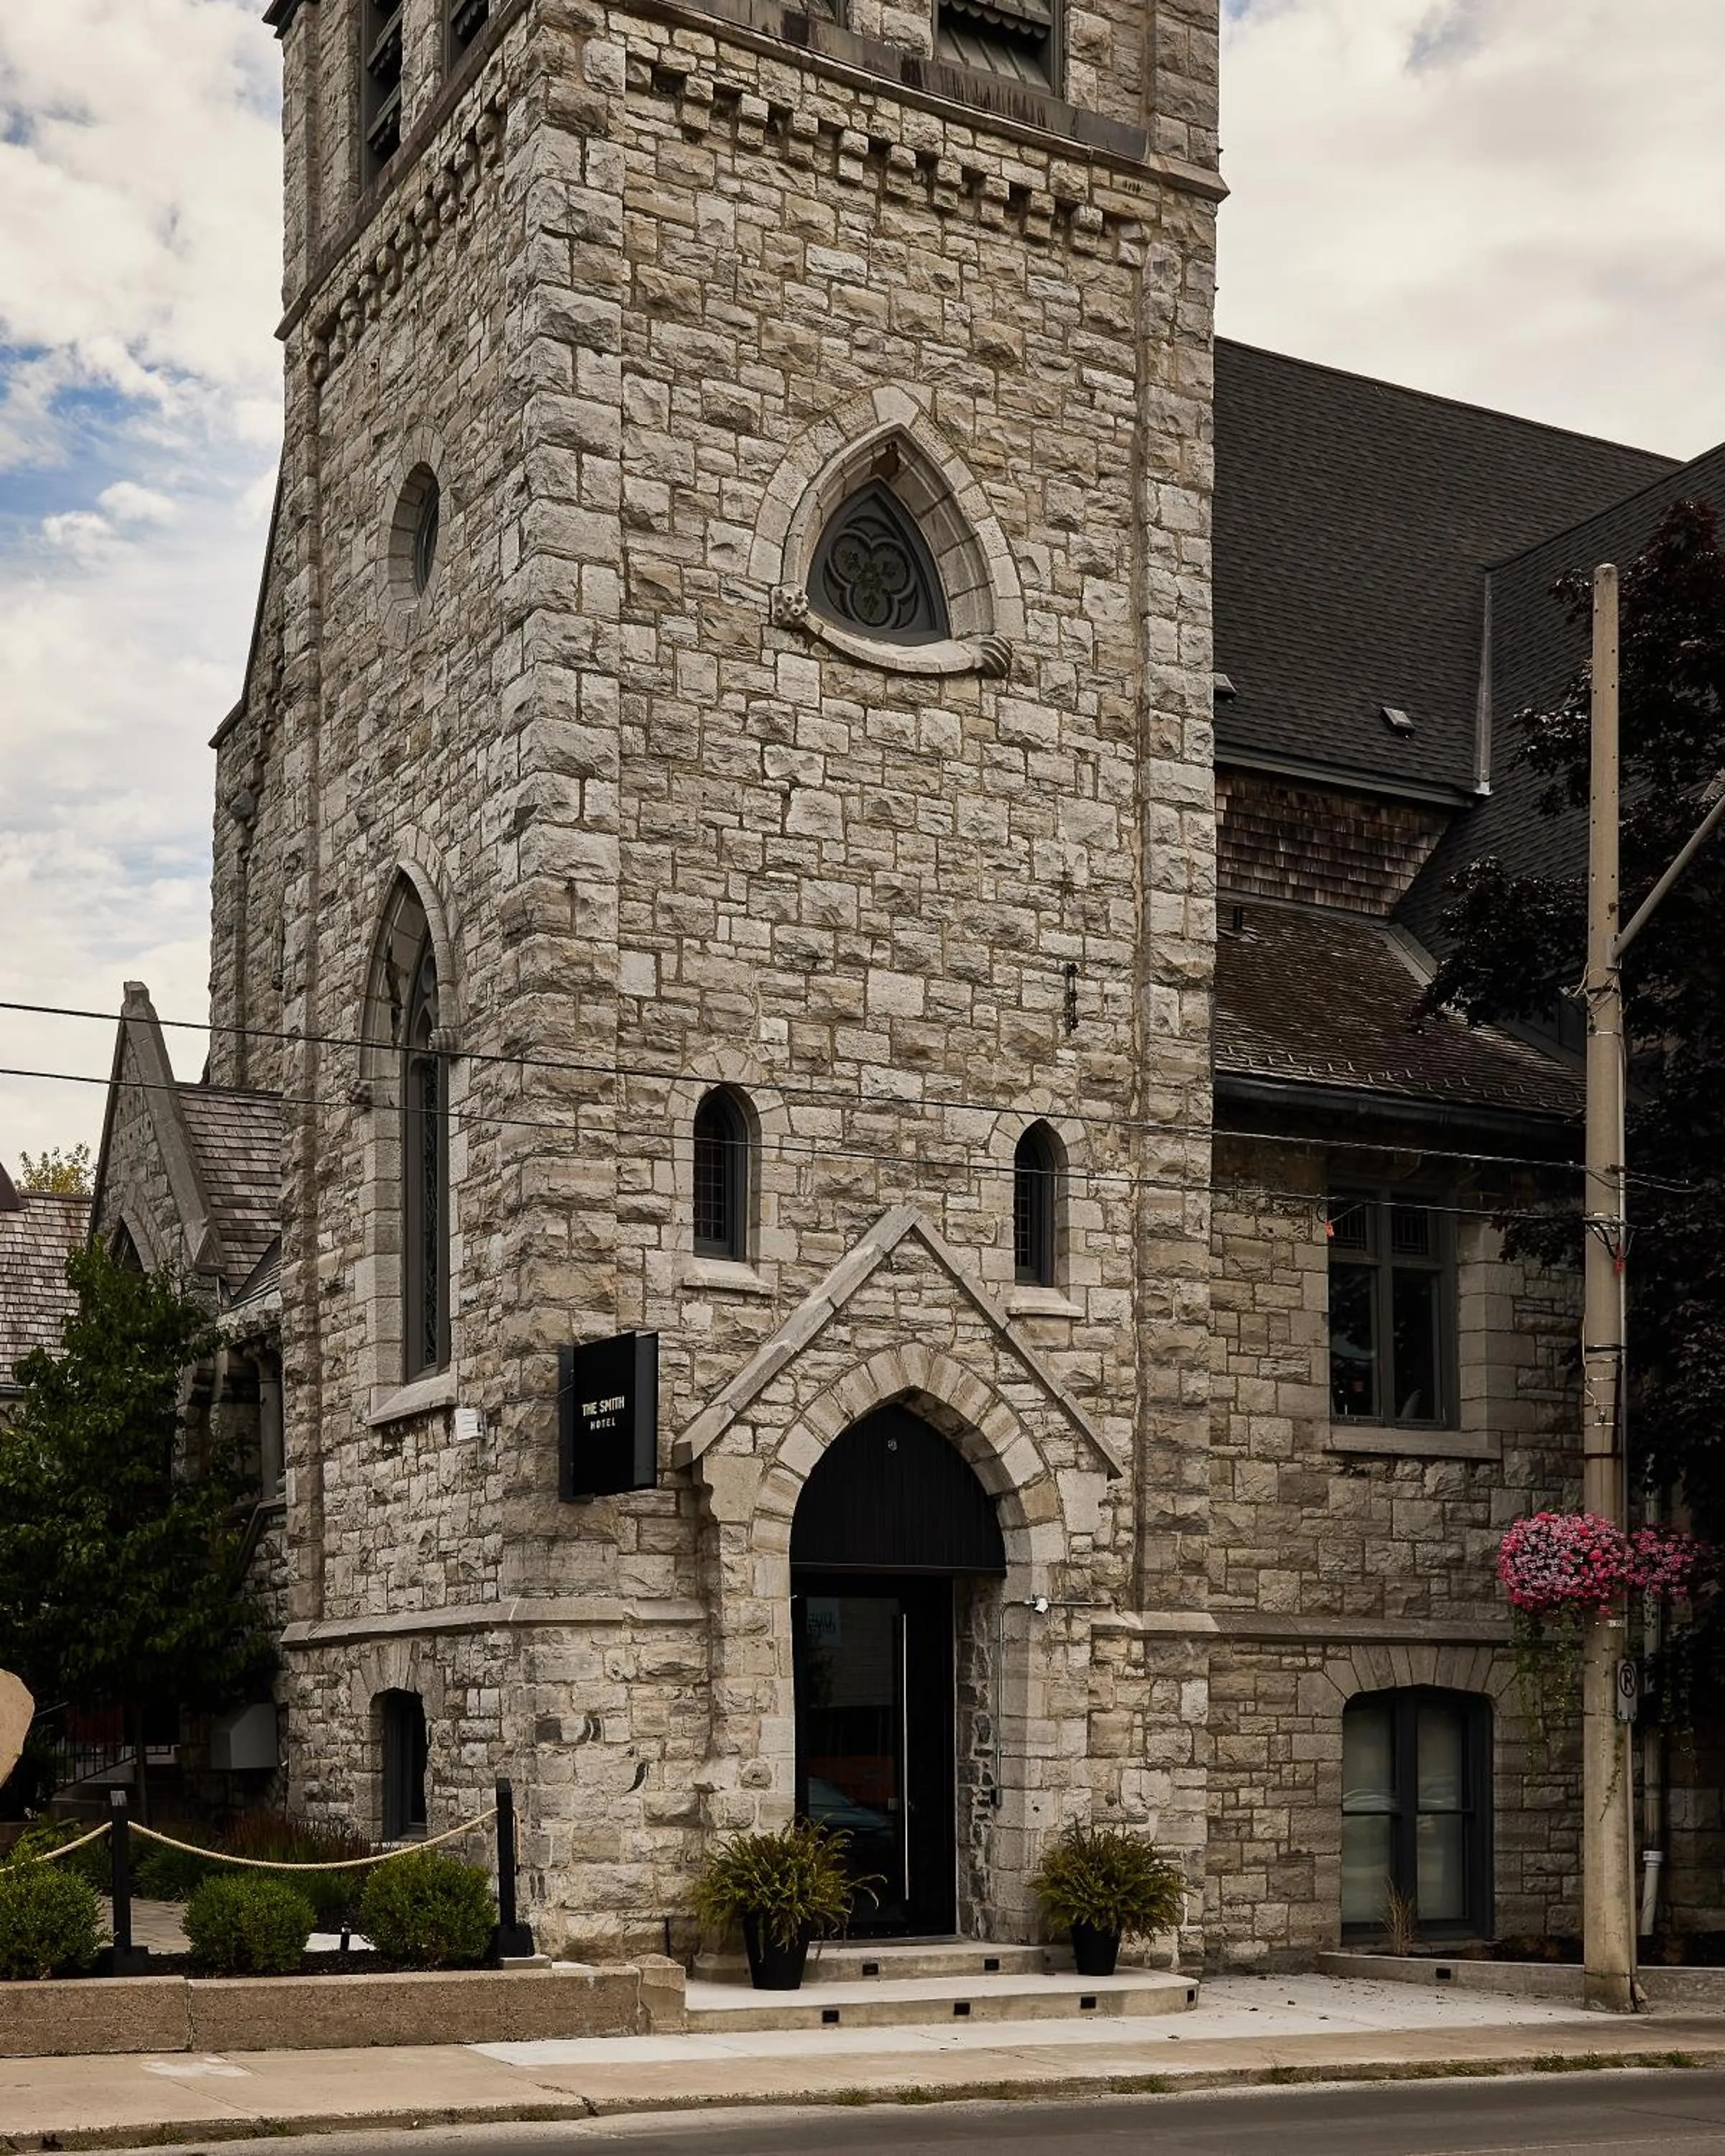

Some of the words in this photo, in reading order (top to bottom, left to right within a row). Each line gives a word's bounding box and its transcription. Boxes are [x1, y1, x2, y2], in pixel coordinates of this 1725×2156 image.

[582, 1401, 597, 1416] THE
[599, 1396, 625, 1414] SMITH
[590, 1417, 616, 1431] HOTEL
